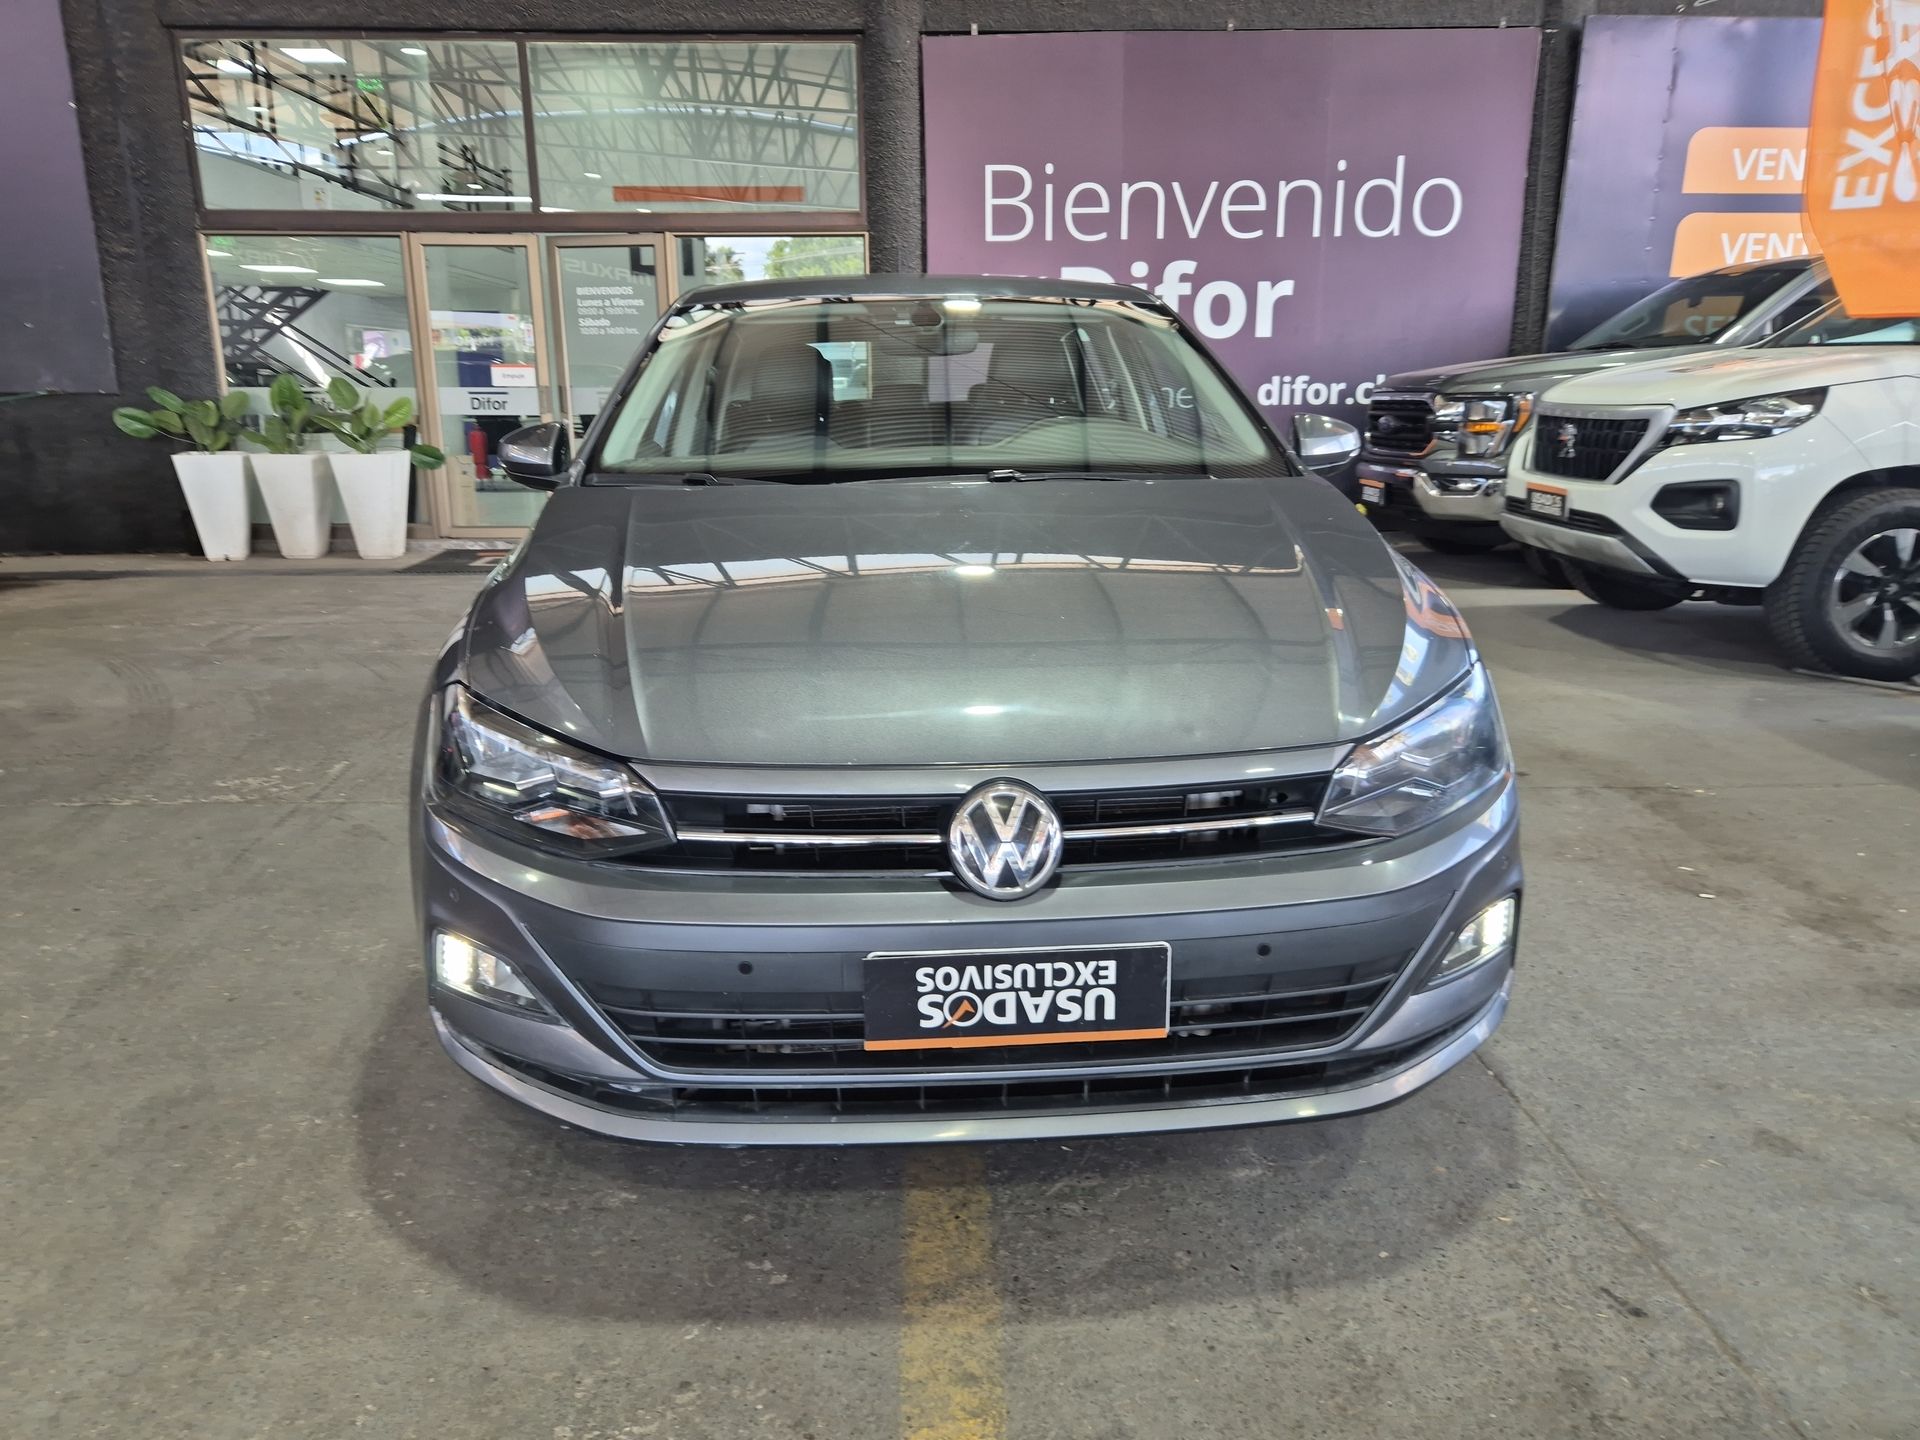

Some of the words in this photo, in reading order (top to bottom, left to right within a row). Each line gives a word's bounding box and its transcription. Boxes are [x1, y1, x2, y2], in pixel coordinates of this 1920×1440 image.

[1830, 0, 1896, 210] EXCE
[984, 155, 1463, 242] Bienvenido
[576, 286, 634, 296] BIENVENIDOS
[577, 298, 603, 307] Lunes
[611, 297, 645, 306] Viernes
[1060, 259, 1295, 338] for
[578, 317, 611, 327] Sábado
[470, 396, 508, 411] Difor
[915, 960, 1118, 991] EXCLUSIVOS
[917, 987, 1116, 1028] USADOS
